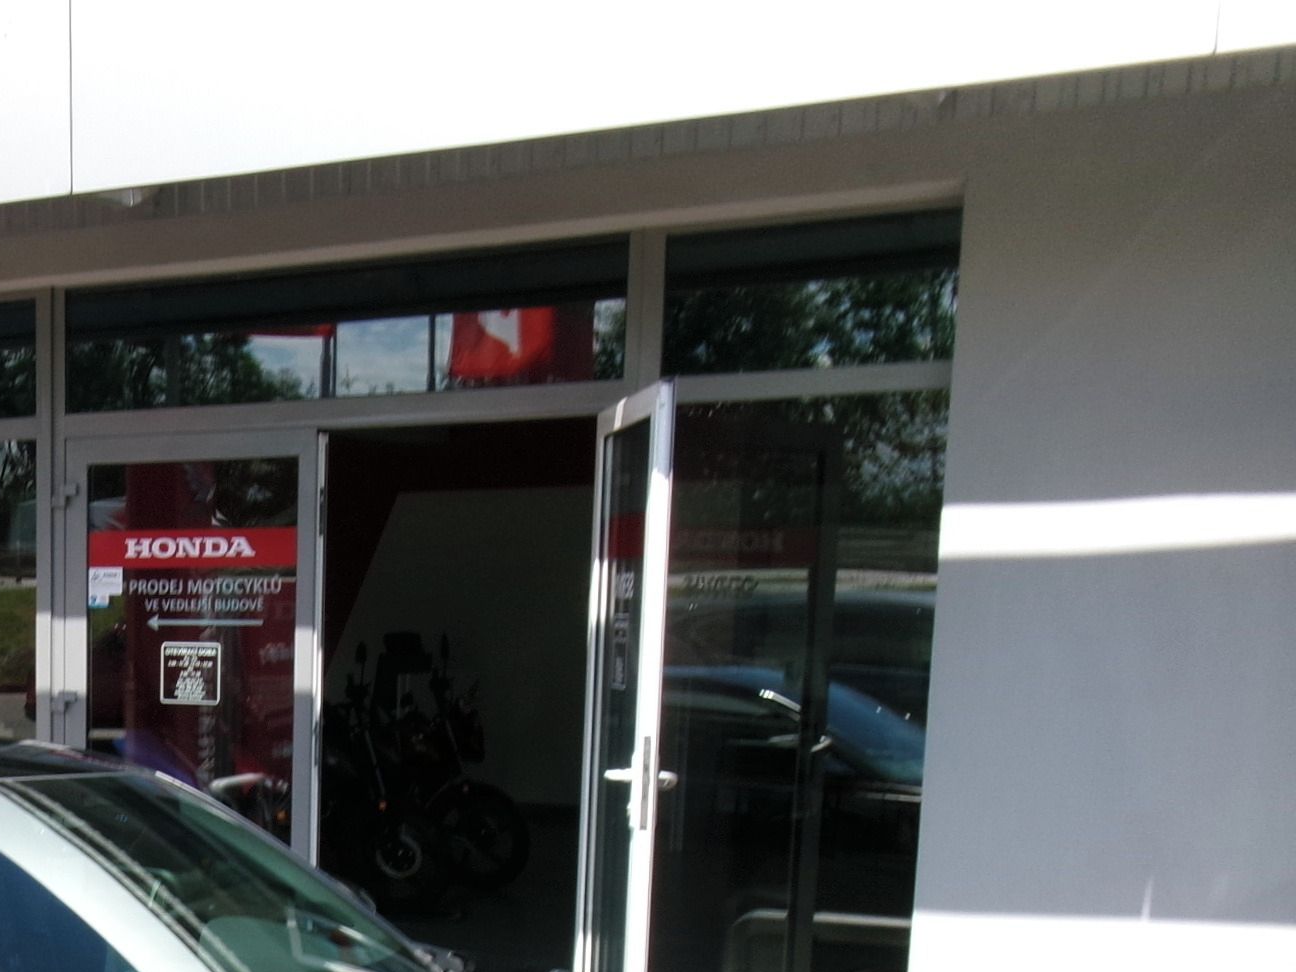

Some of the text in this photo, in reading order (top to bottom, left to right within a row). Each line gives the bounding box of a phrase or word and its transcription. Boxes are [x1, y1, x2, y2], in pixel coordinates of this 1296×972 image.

[124, 536, 255, 559] HONDA
[128, 579, 183, 595] PRODEJ
[145, 598, 159, 612] VE
